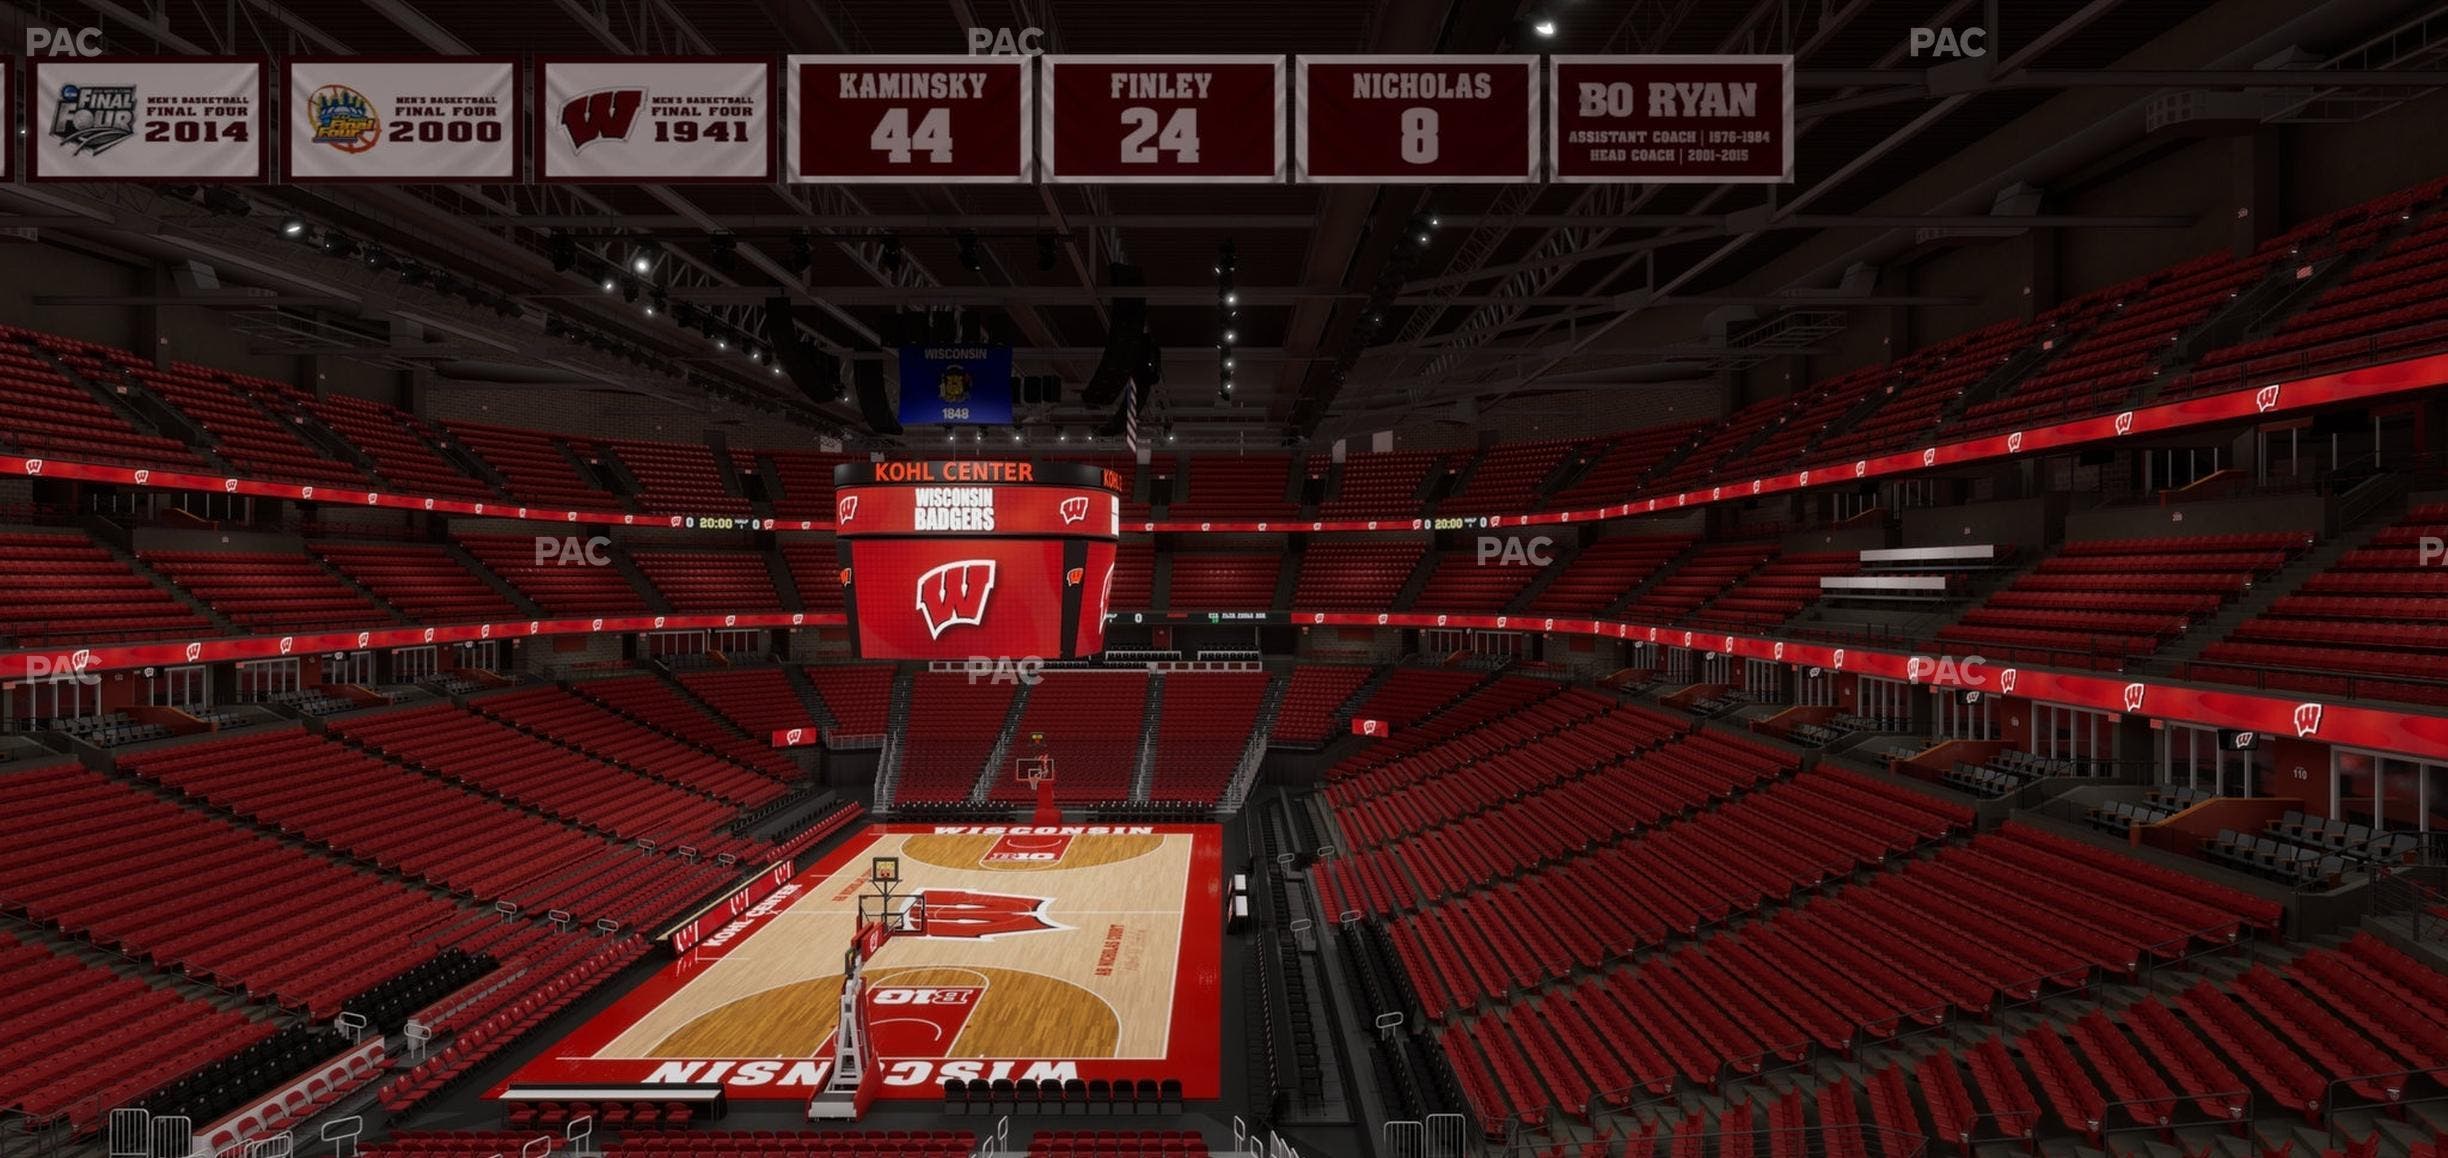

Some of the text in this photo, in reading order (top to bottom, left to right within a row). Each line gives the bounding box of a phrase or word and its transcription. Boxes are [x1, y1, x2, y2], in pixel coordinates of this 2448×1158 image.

[839, 73, 987, 99] KAMINSKY
[1110, 73, 1213, 99] FINLEY
[1352, 73, 1492, 99] NICHOLAS
[78, 87, 135, 110] FINAL
[1578, 82, 1758, 117] BO RYAN
[146, 107, 248, 116] FINAL FOUR
[395, 107, 497, 116] FINAL FOUR
[651, 107, 753, 116] FINAL FOUR
[145, 121, 248, 142] 2014
[389, 121, 501, 142] 2000
[654, 121, 748, 142] 1941
[870, 107, 953, 164] 44
[1120, 107, 1200, 164] 24
[1400, 107, 1440, 164] 8
[1568, 130, 1648, 144] ASSISTANT
[1652, 130, 1697, 144] COACH
[1590, 149, 1627, 162] HEAD
[1630, 149, 1675, 162] COACH
[925, 347, 988, 360] WISCONSIN
[942, 407, 969, 420] 1848
[875, 461, 1034, 482] KOHL CENTER
[914, 488, 993, 507] WISCONSIN
[699, 518, 733, 529] 20:00
[914, 508, 995, 531] BADGERS
[1434, 518, 1463, 530] 20:00
[915, 559, 997, 640] W
[934, 826, 1154, 835] WISCONSIN
[703, 918, 754, 947] KOHL
[751, 884, 803, 918] CENTER
